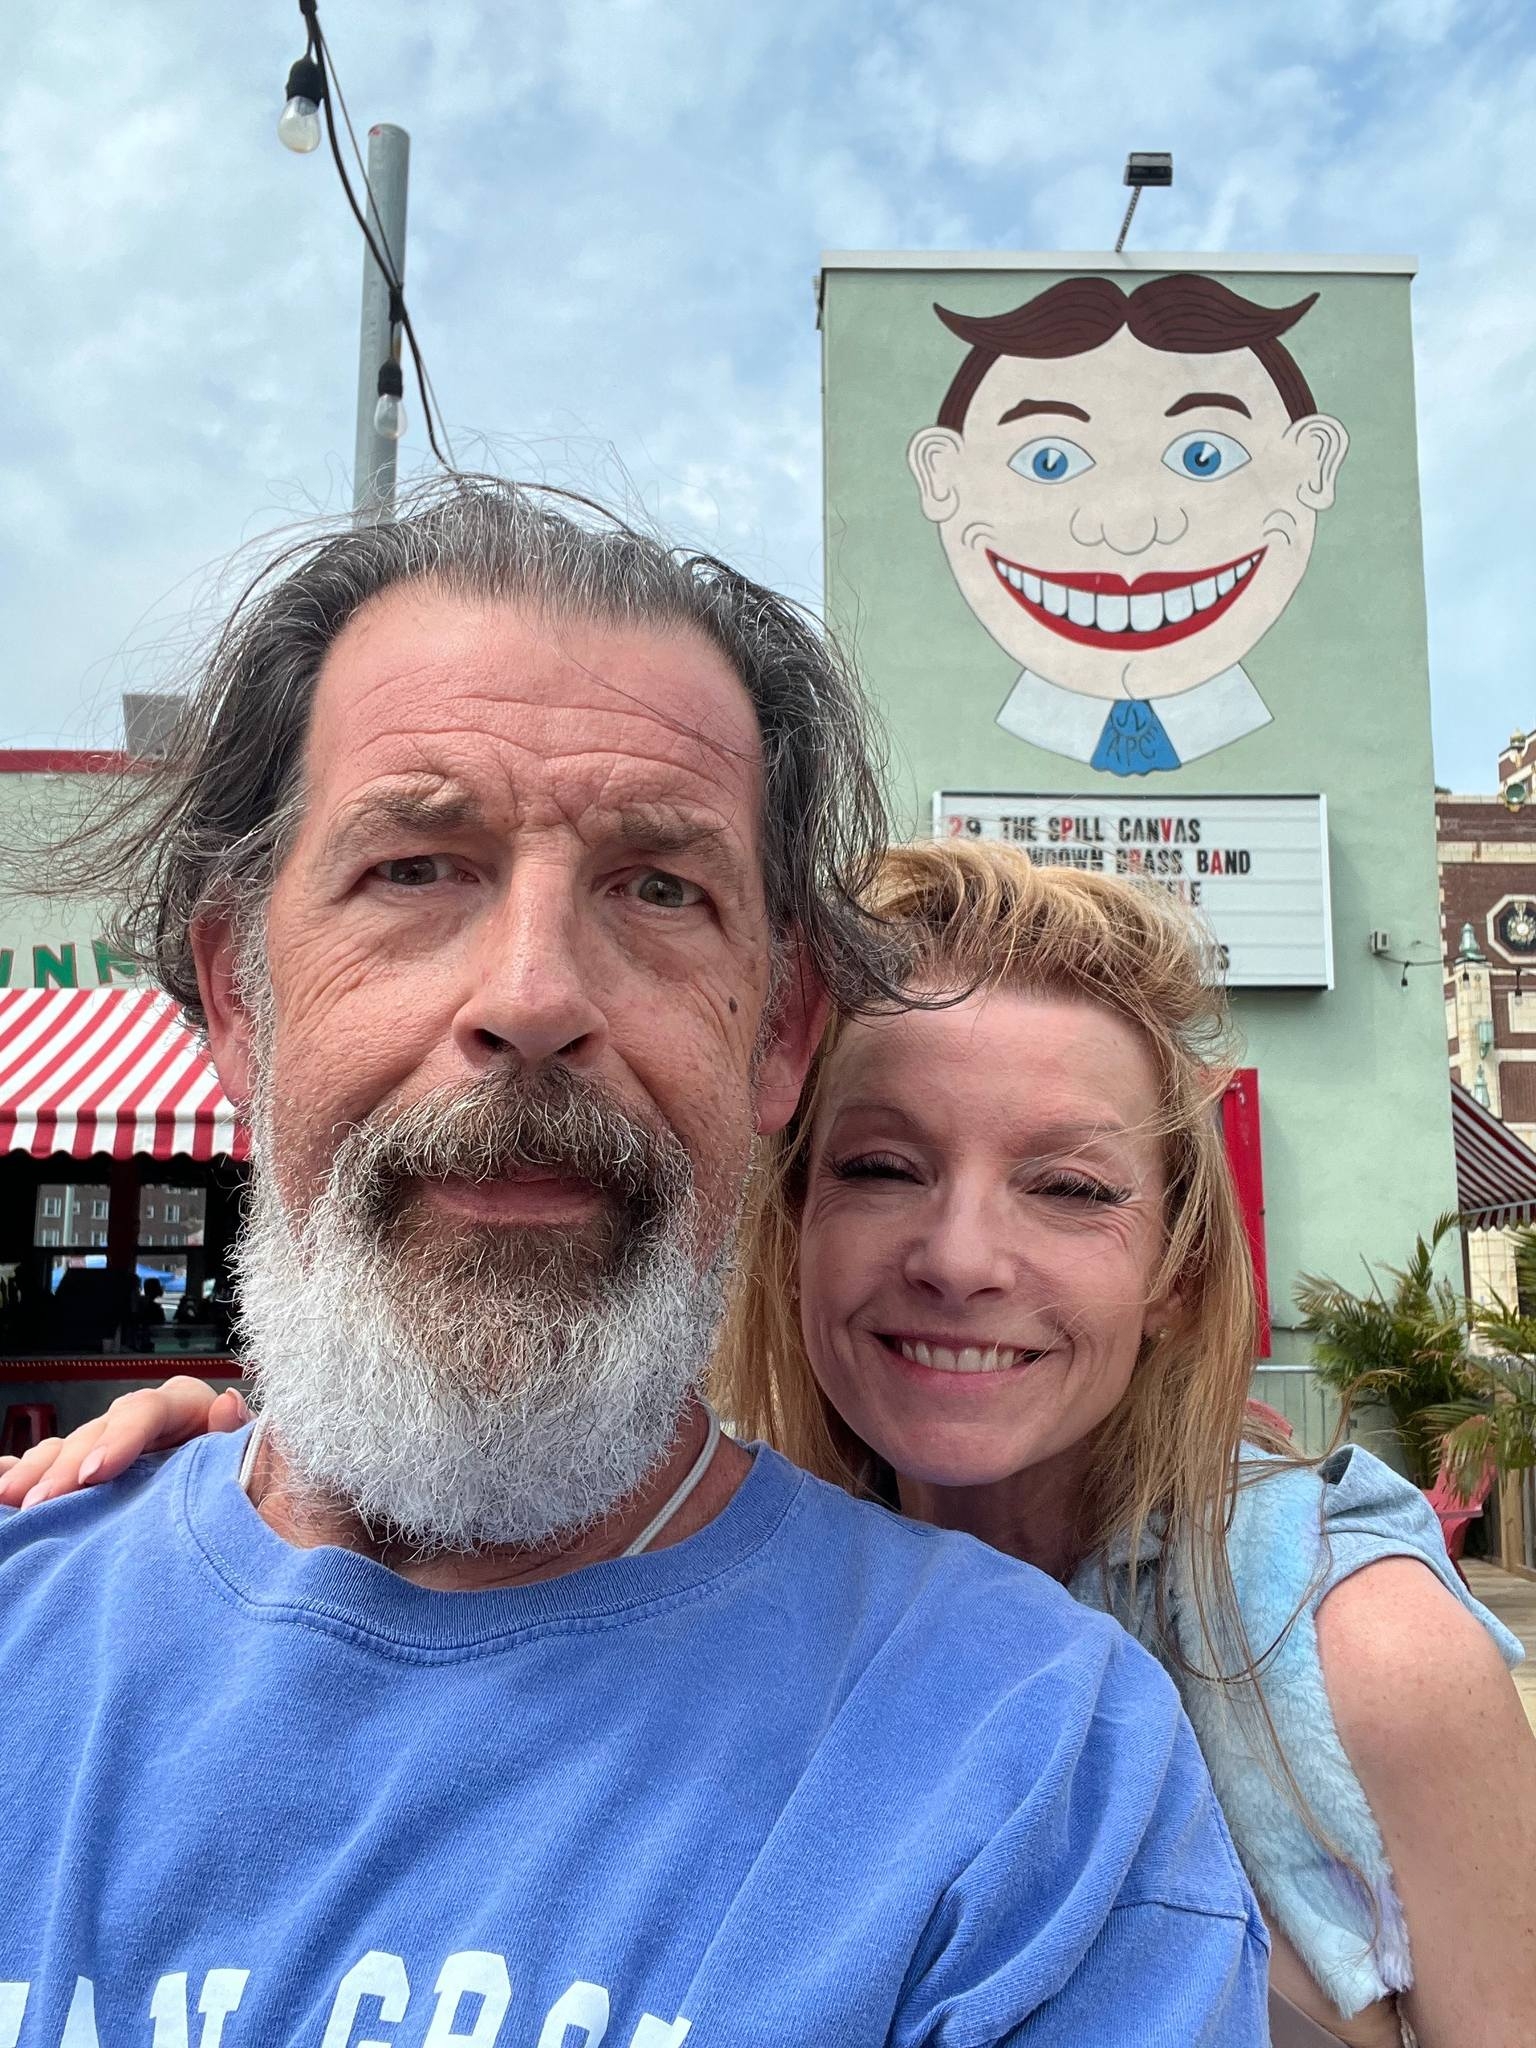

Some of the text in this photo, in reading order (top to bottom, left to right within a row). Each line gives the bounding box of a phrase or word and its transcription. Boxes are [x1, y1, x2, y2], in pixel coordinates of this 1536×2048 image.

[1000, 816, 1037, 840] THE
[1048, 816, 1105, 841] SPILL
[1118, 816, 1201, 842] CANVAS
[1115, 848, 1182, 874] BRASS
[1196, 848, 1251, 875] BAND
